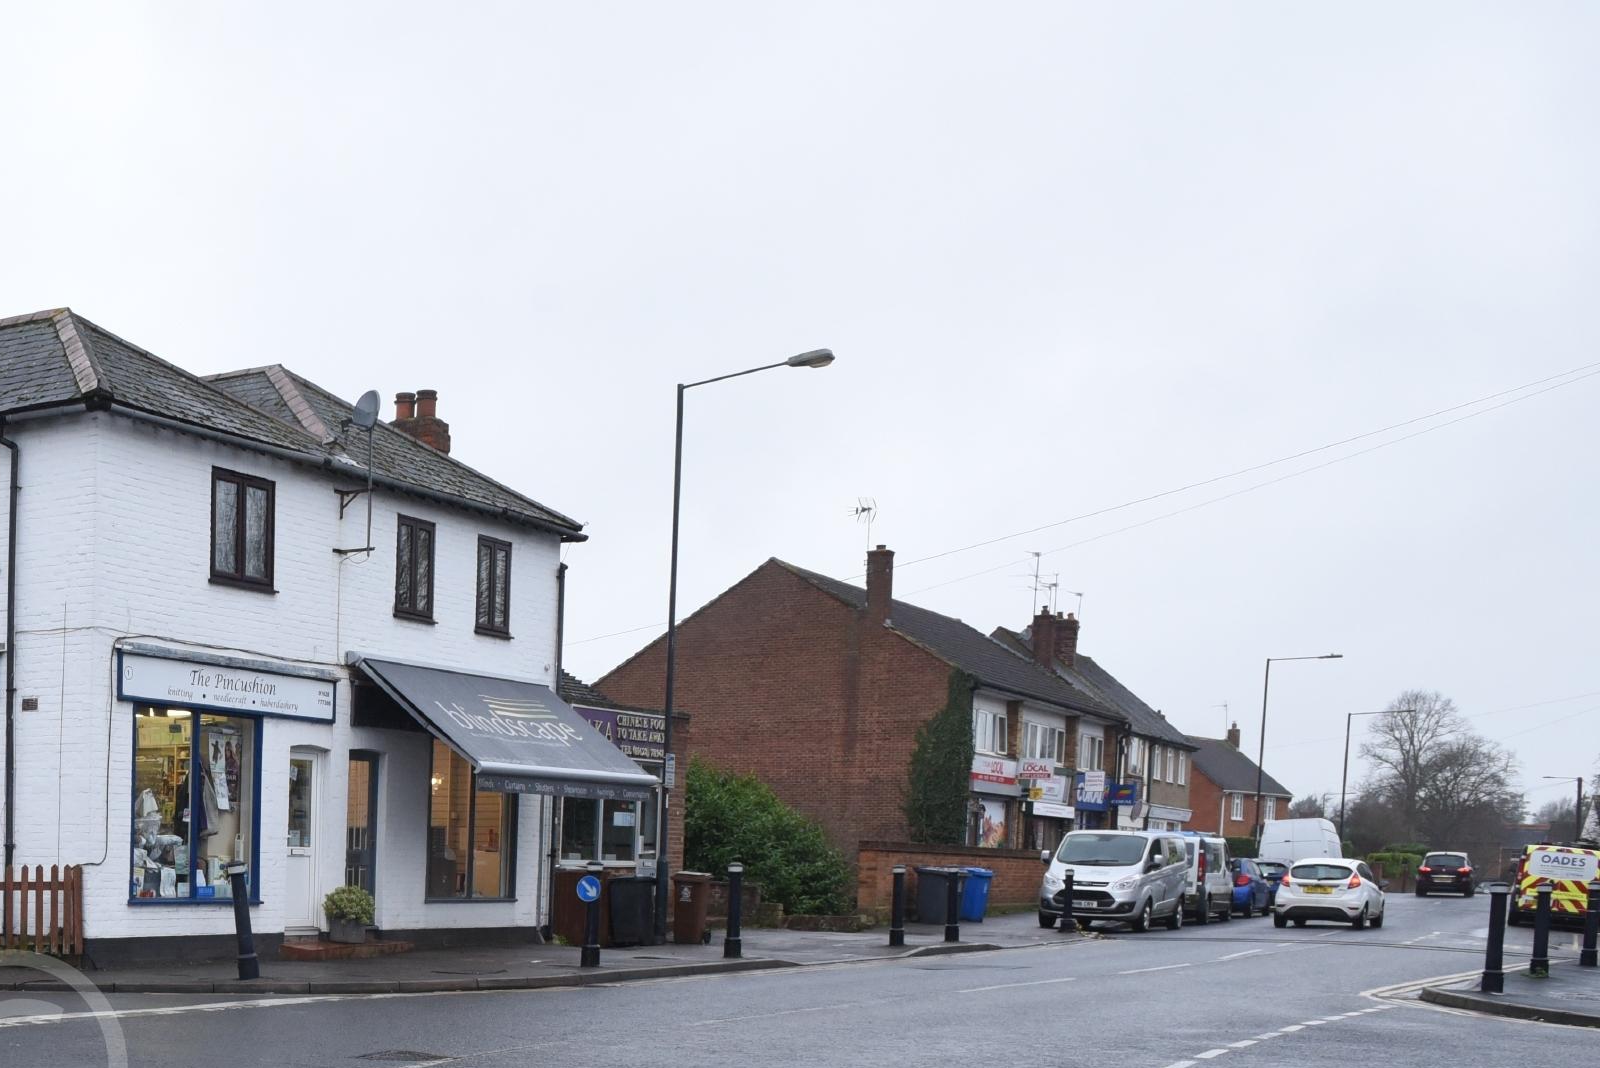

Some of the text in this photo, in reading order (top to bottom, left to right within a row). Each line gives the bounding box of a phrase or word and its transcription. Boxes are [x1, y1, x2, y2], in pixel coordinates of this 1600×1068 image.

[190, 669, 277, 696] The Pincushion
[167, 687, 299, 712] knitting needlecraft haberdashery
[434, 701, 583, 747] blindscape
[616, 715, 649, 728] CHINESE
[617, 728, 627, 739] TO
[628, 729, 648, 741] TAKE
[1023, 764, 1048, 772] LOCAL
[504, 780, 526, 791] Curtains
[1541, 854, 1587, 867] OADES
